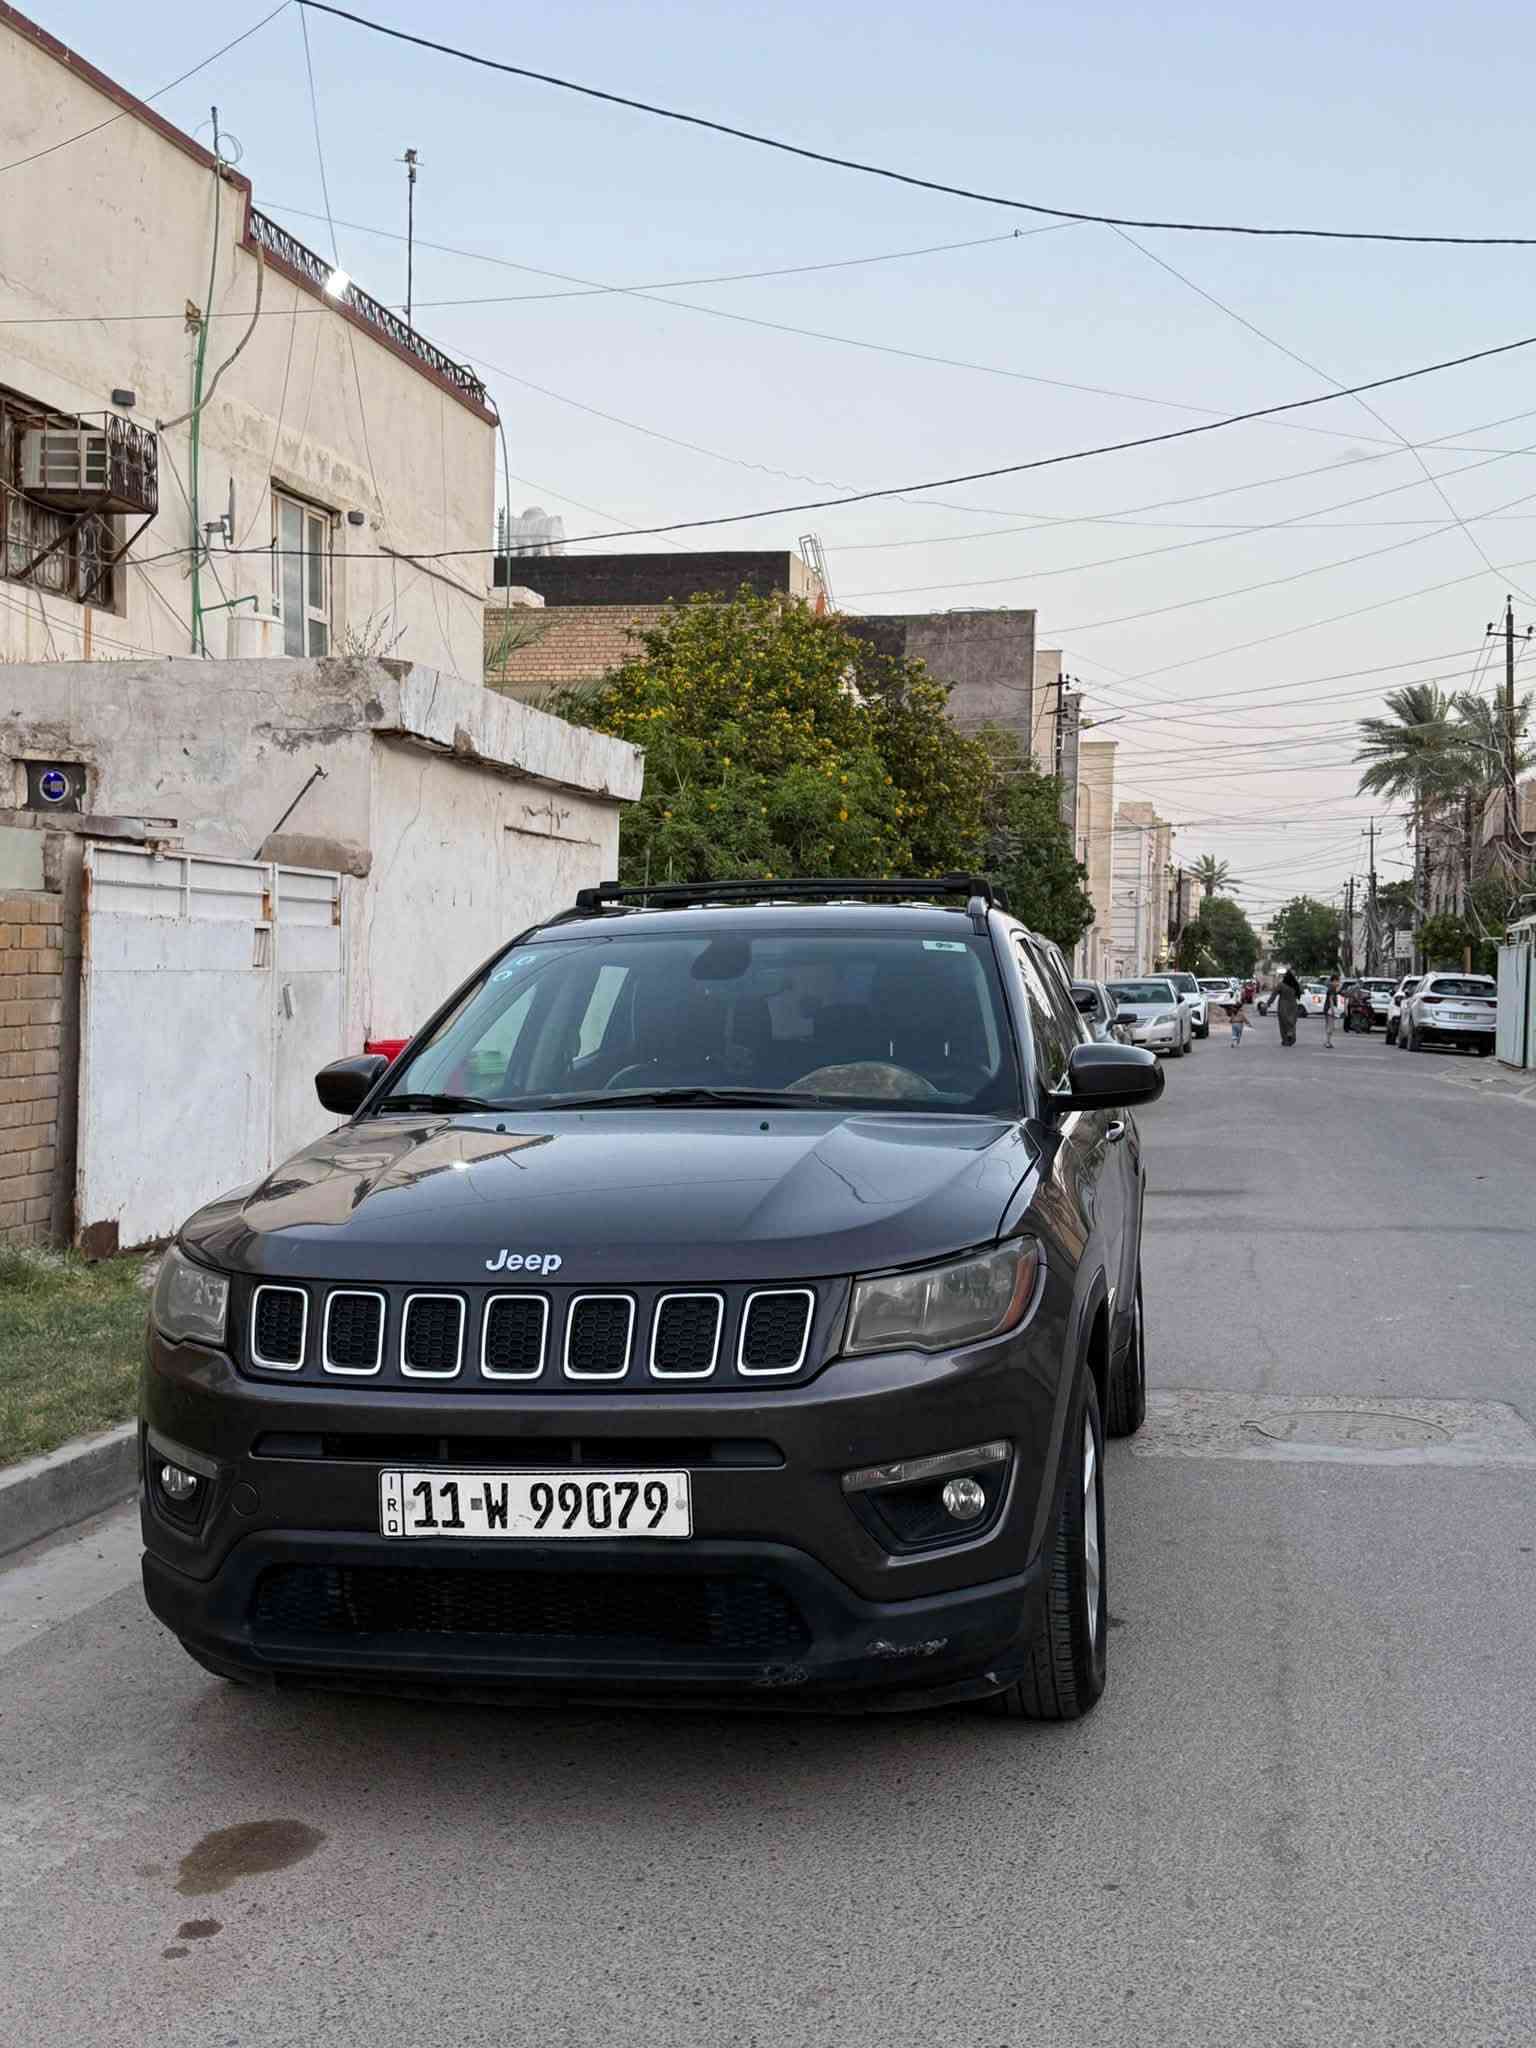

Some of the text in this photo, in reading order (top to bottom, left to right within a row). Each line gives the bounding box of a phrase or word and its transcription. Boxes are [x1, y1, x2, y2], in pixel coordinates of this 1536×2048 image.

[486, 1249, 562, 1275] Jeep
[413, 1481, 465, 1529] 11
[530, 1481, 669, 1529] 99079
